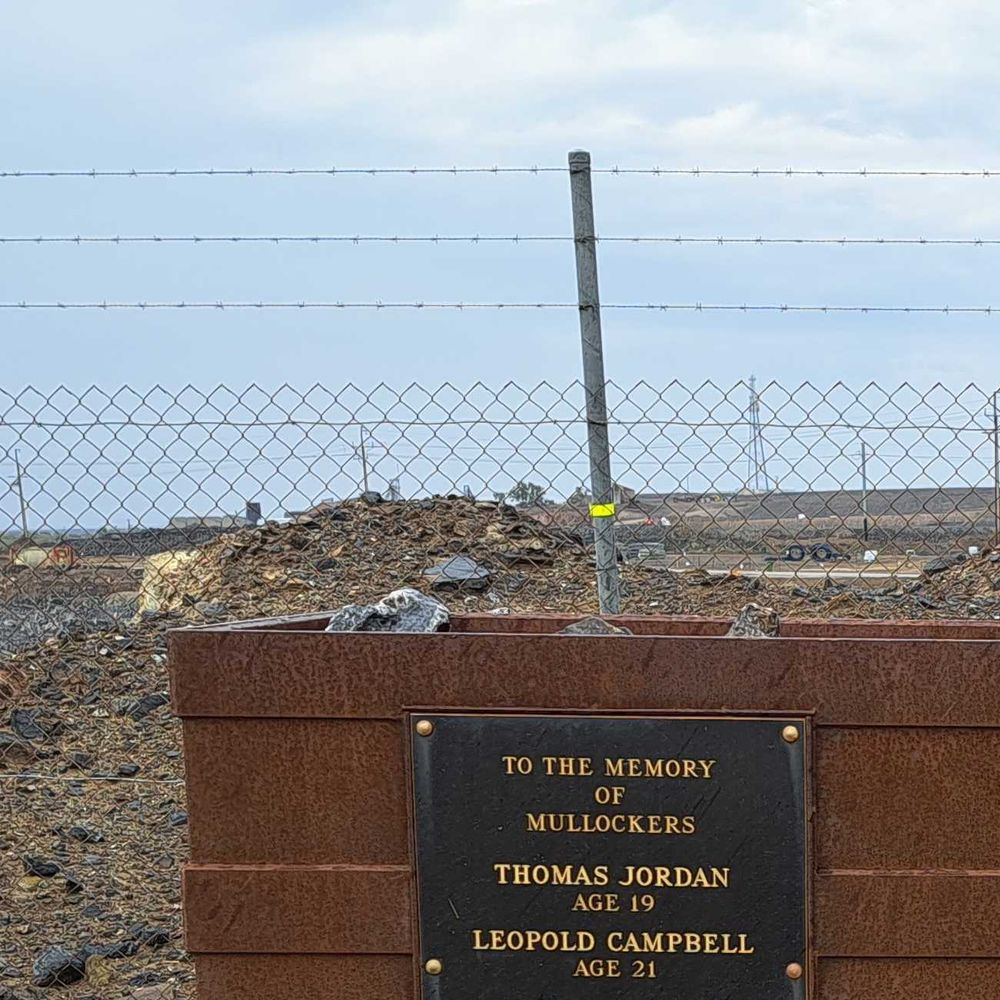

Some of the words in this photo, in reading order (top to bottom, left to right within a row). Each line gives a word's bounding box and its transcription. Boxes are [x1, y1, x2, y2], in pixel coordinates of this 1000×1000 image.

[502, 756, 533, 776] TO
[543, 757, 593, 777] THE
[605, 759, 716, 778] MEMORY
[595, 786, 625, 805] OF
[526, 815, 696, 833] MULLOCKERS
[494, 865, 609, 886] THOMAS
[618, 866, 731, 888] JORDAN
[572, 894, 619, 912] AGE
[630, 894, 655, 913] 19
[472, 931, 595, 952] LEOPOLD
[607, 932, 755, 954] CAMPBELL
[572, 960, 620, 978] AGE
[632, 960, 657, 979] 21
